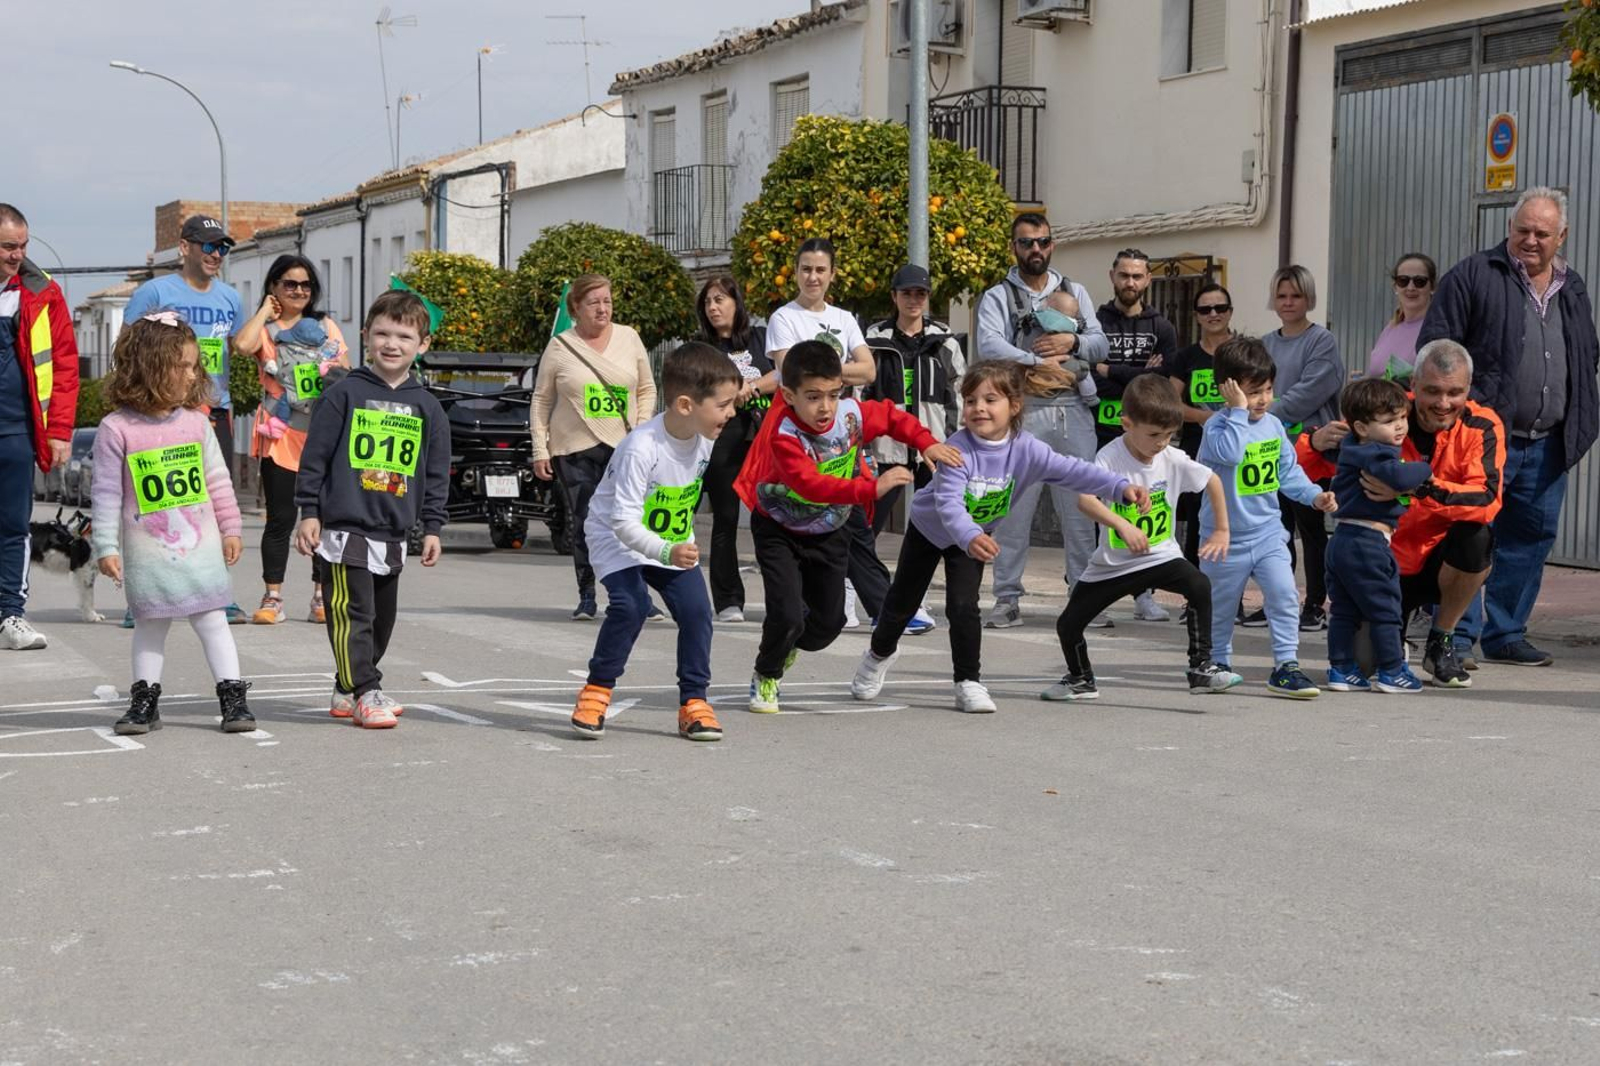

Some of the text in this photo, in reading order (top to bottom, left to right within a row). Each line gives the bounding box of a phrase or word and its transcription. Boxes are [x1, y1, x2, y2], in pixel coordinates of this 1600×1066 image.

[175, 306, 235, 325] DIDAS
[301, 376, 323, 393] 06
[1195, 382, 1221, 397] 05
[354, 433, 415, 467] 018
[142, 466, 202, 503] 066
[966, 496, 1007, 520] 58
[648, 506, 694, 536] 03
